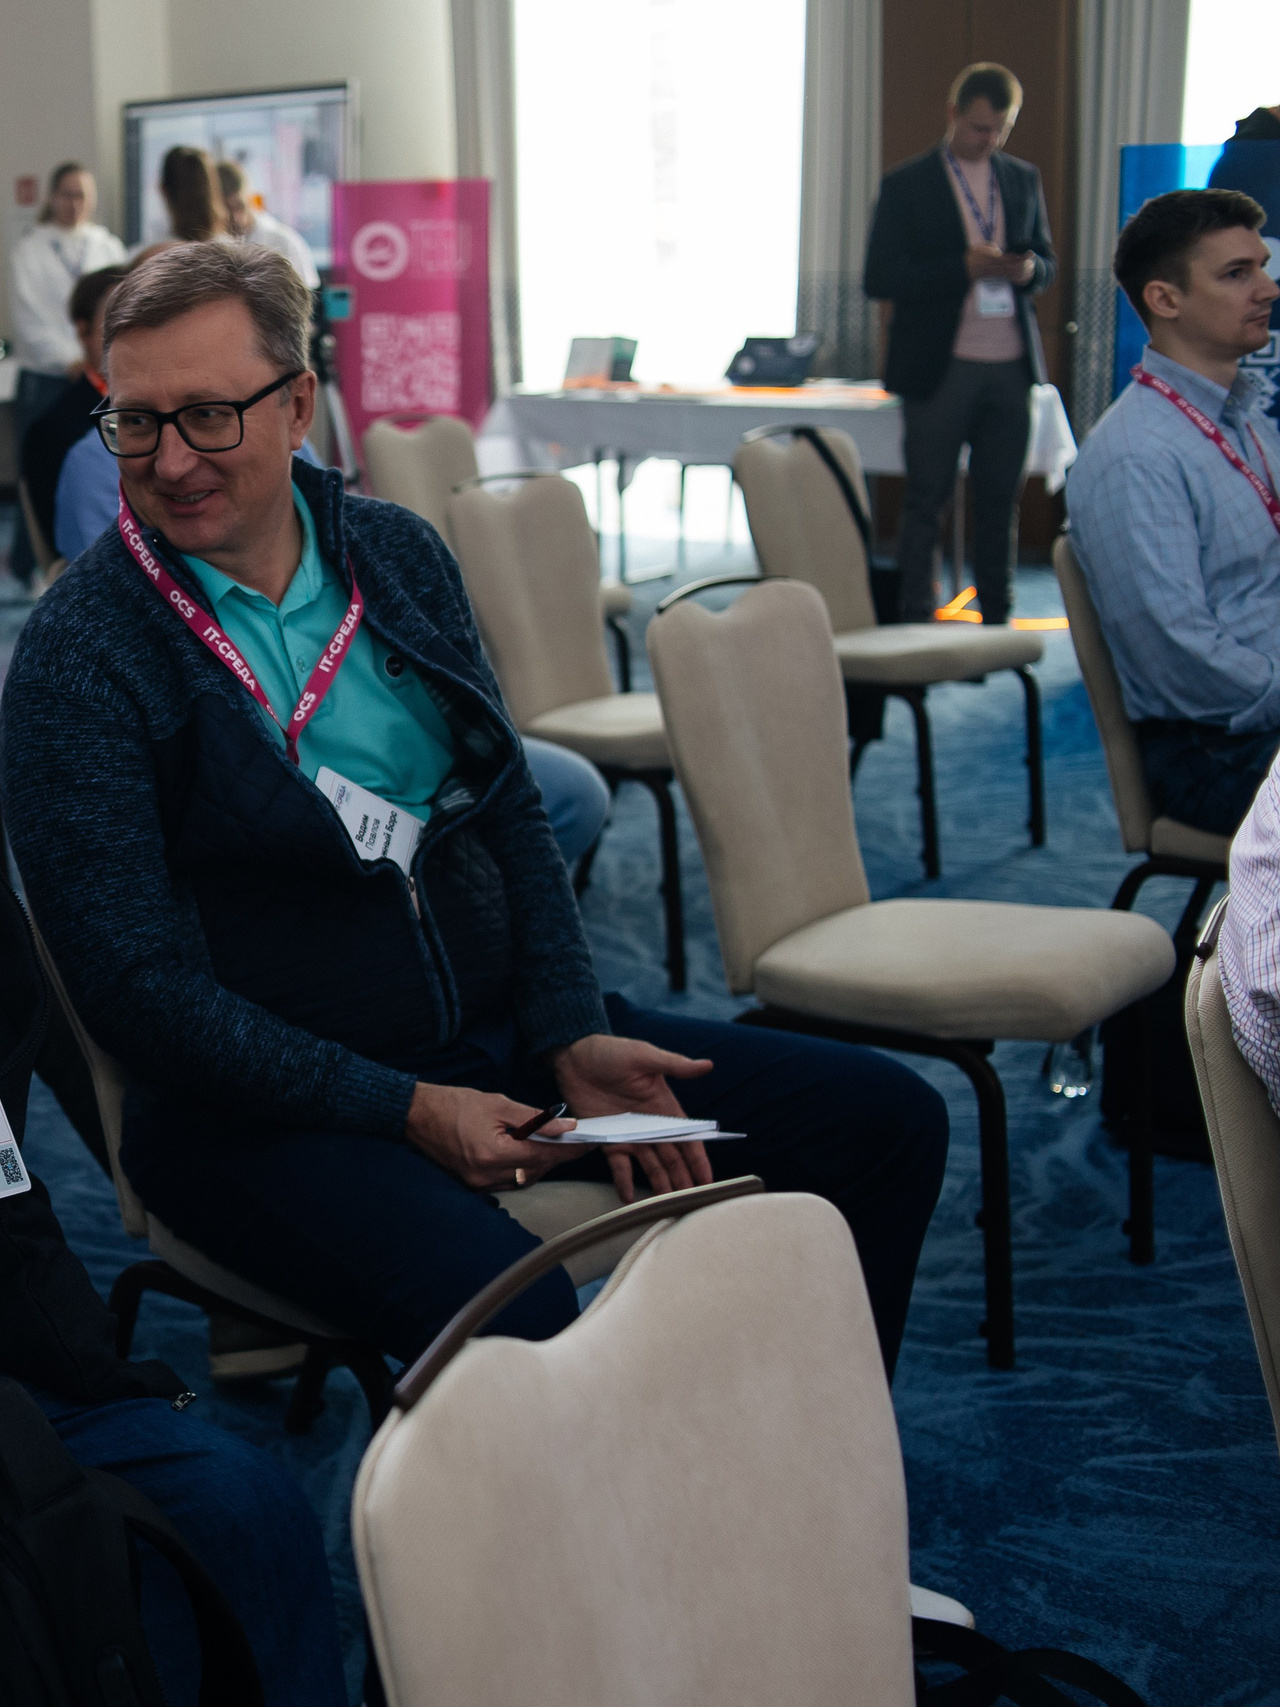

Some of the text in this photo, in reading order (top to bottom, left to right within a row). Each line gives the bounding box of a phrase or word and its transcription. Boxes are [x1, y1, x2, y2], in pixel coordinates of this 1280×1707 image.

[122, 519, 160, 581] IT-СРЕДА
[170, 590, 196, 619] OCS
[318, 603, 359, 673] IT-СРЕДА
[203, 626, 257, 691] IT-СРЕДА
[294, 692, 316, 722] OCS
[355, 814, 369, 842] Вадим
[365, 818, 380, 851] Павлов
[385, 810, 398, 833] Барс
